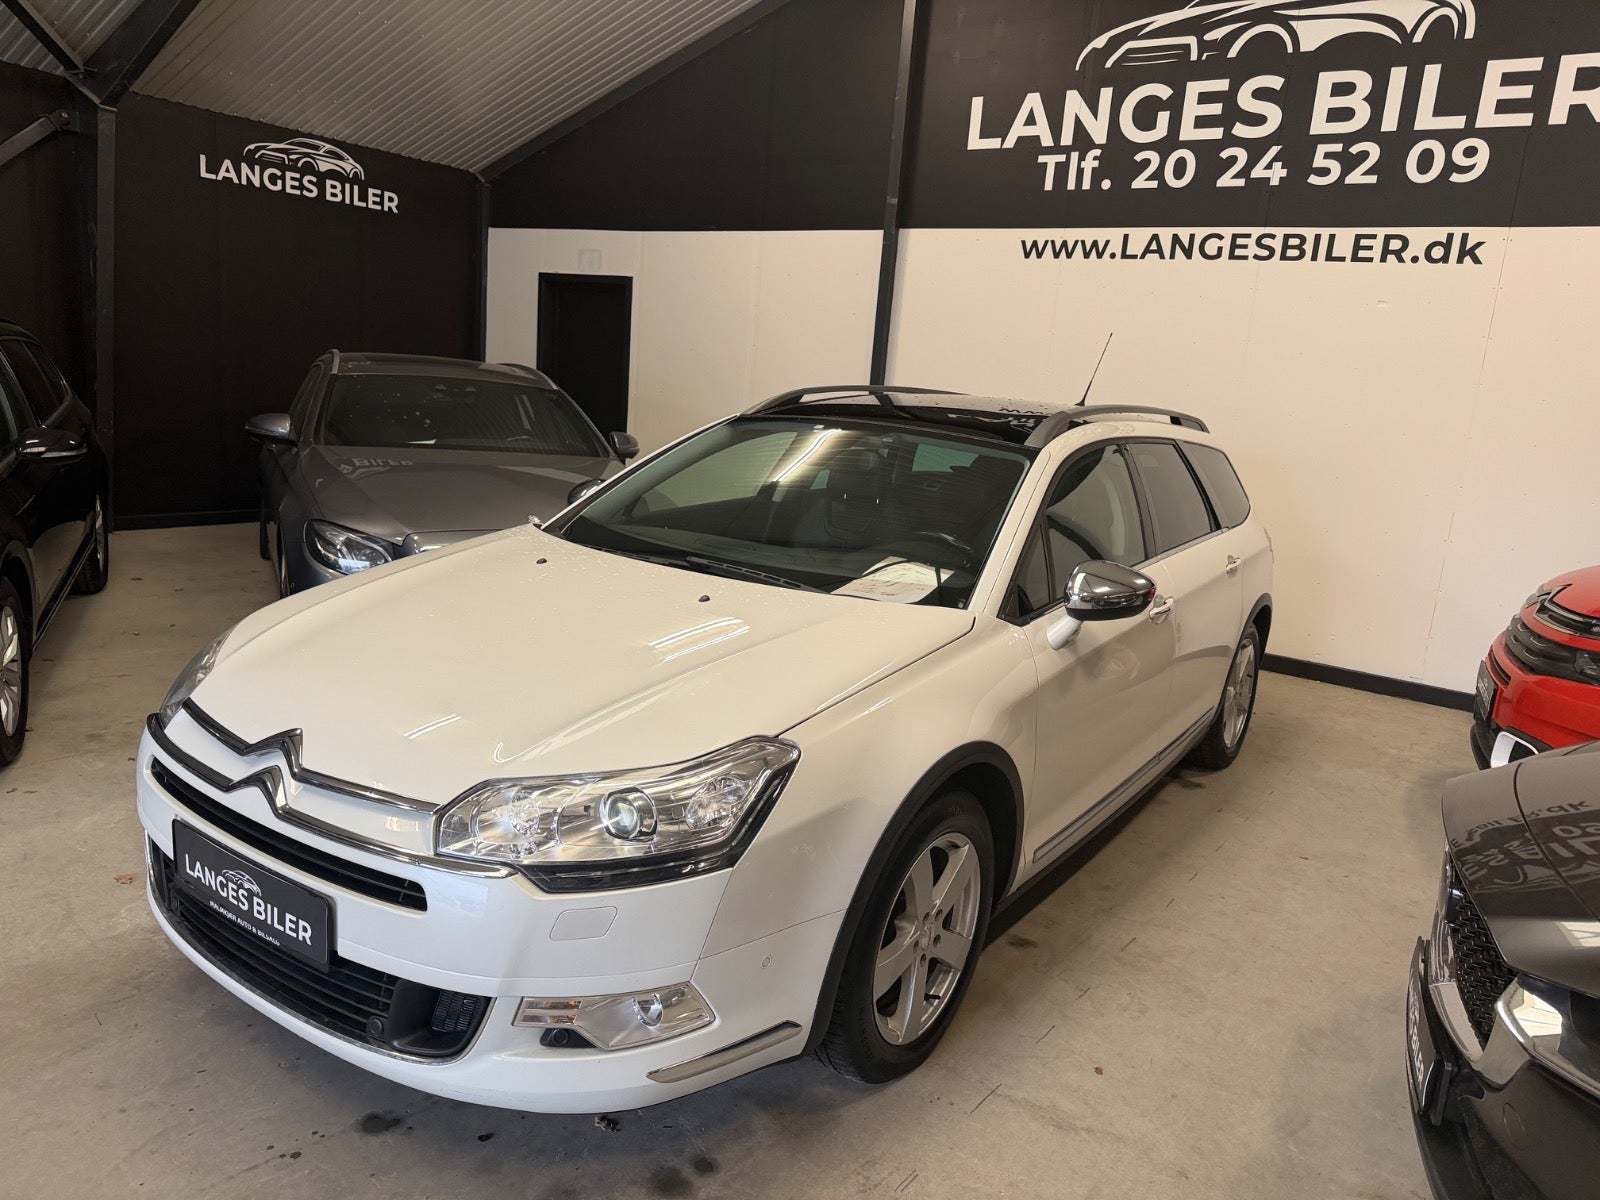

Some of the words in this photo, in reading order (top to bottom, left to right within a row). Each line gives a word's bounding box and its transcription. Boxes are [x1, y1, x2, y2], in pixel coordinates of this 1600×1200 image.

[966, 74, 1286, 151] LANGES
[1309, 52, 1600, 136] BILER
[199, 153, 319, 198] LANGES
[325, 178, 399, 214] BILER
[1037, 148, 1112, 191] Tlf.
[1130, 148, 1196, 189] 20
[1215, 145, 1288, 188] 24
[1306, 141, 1381, 186] 52
[1405, 137, 1490, 184] 09
[1020, 232, 1487, 265] www.LANGESBILER.dk
[185, 853, 249, 911] LANGES
[253, 895, 312, 946] BILER
